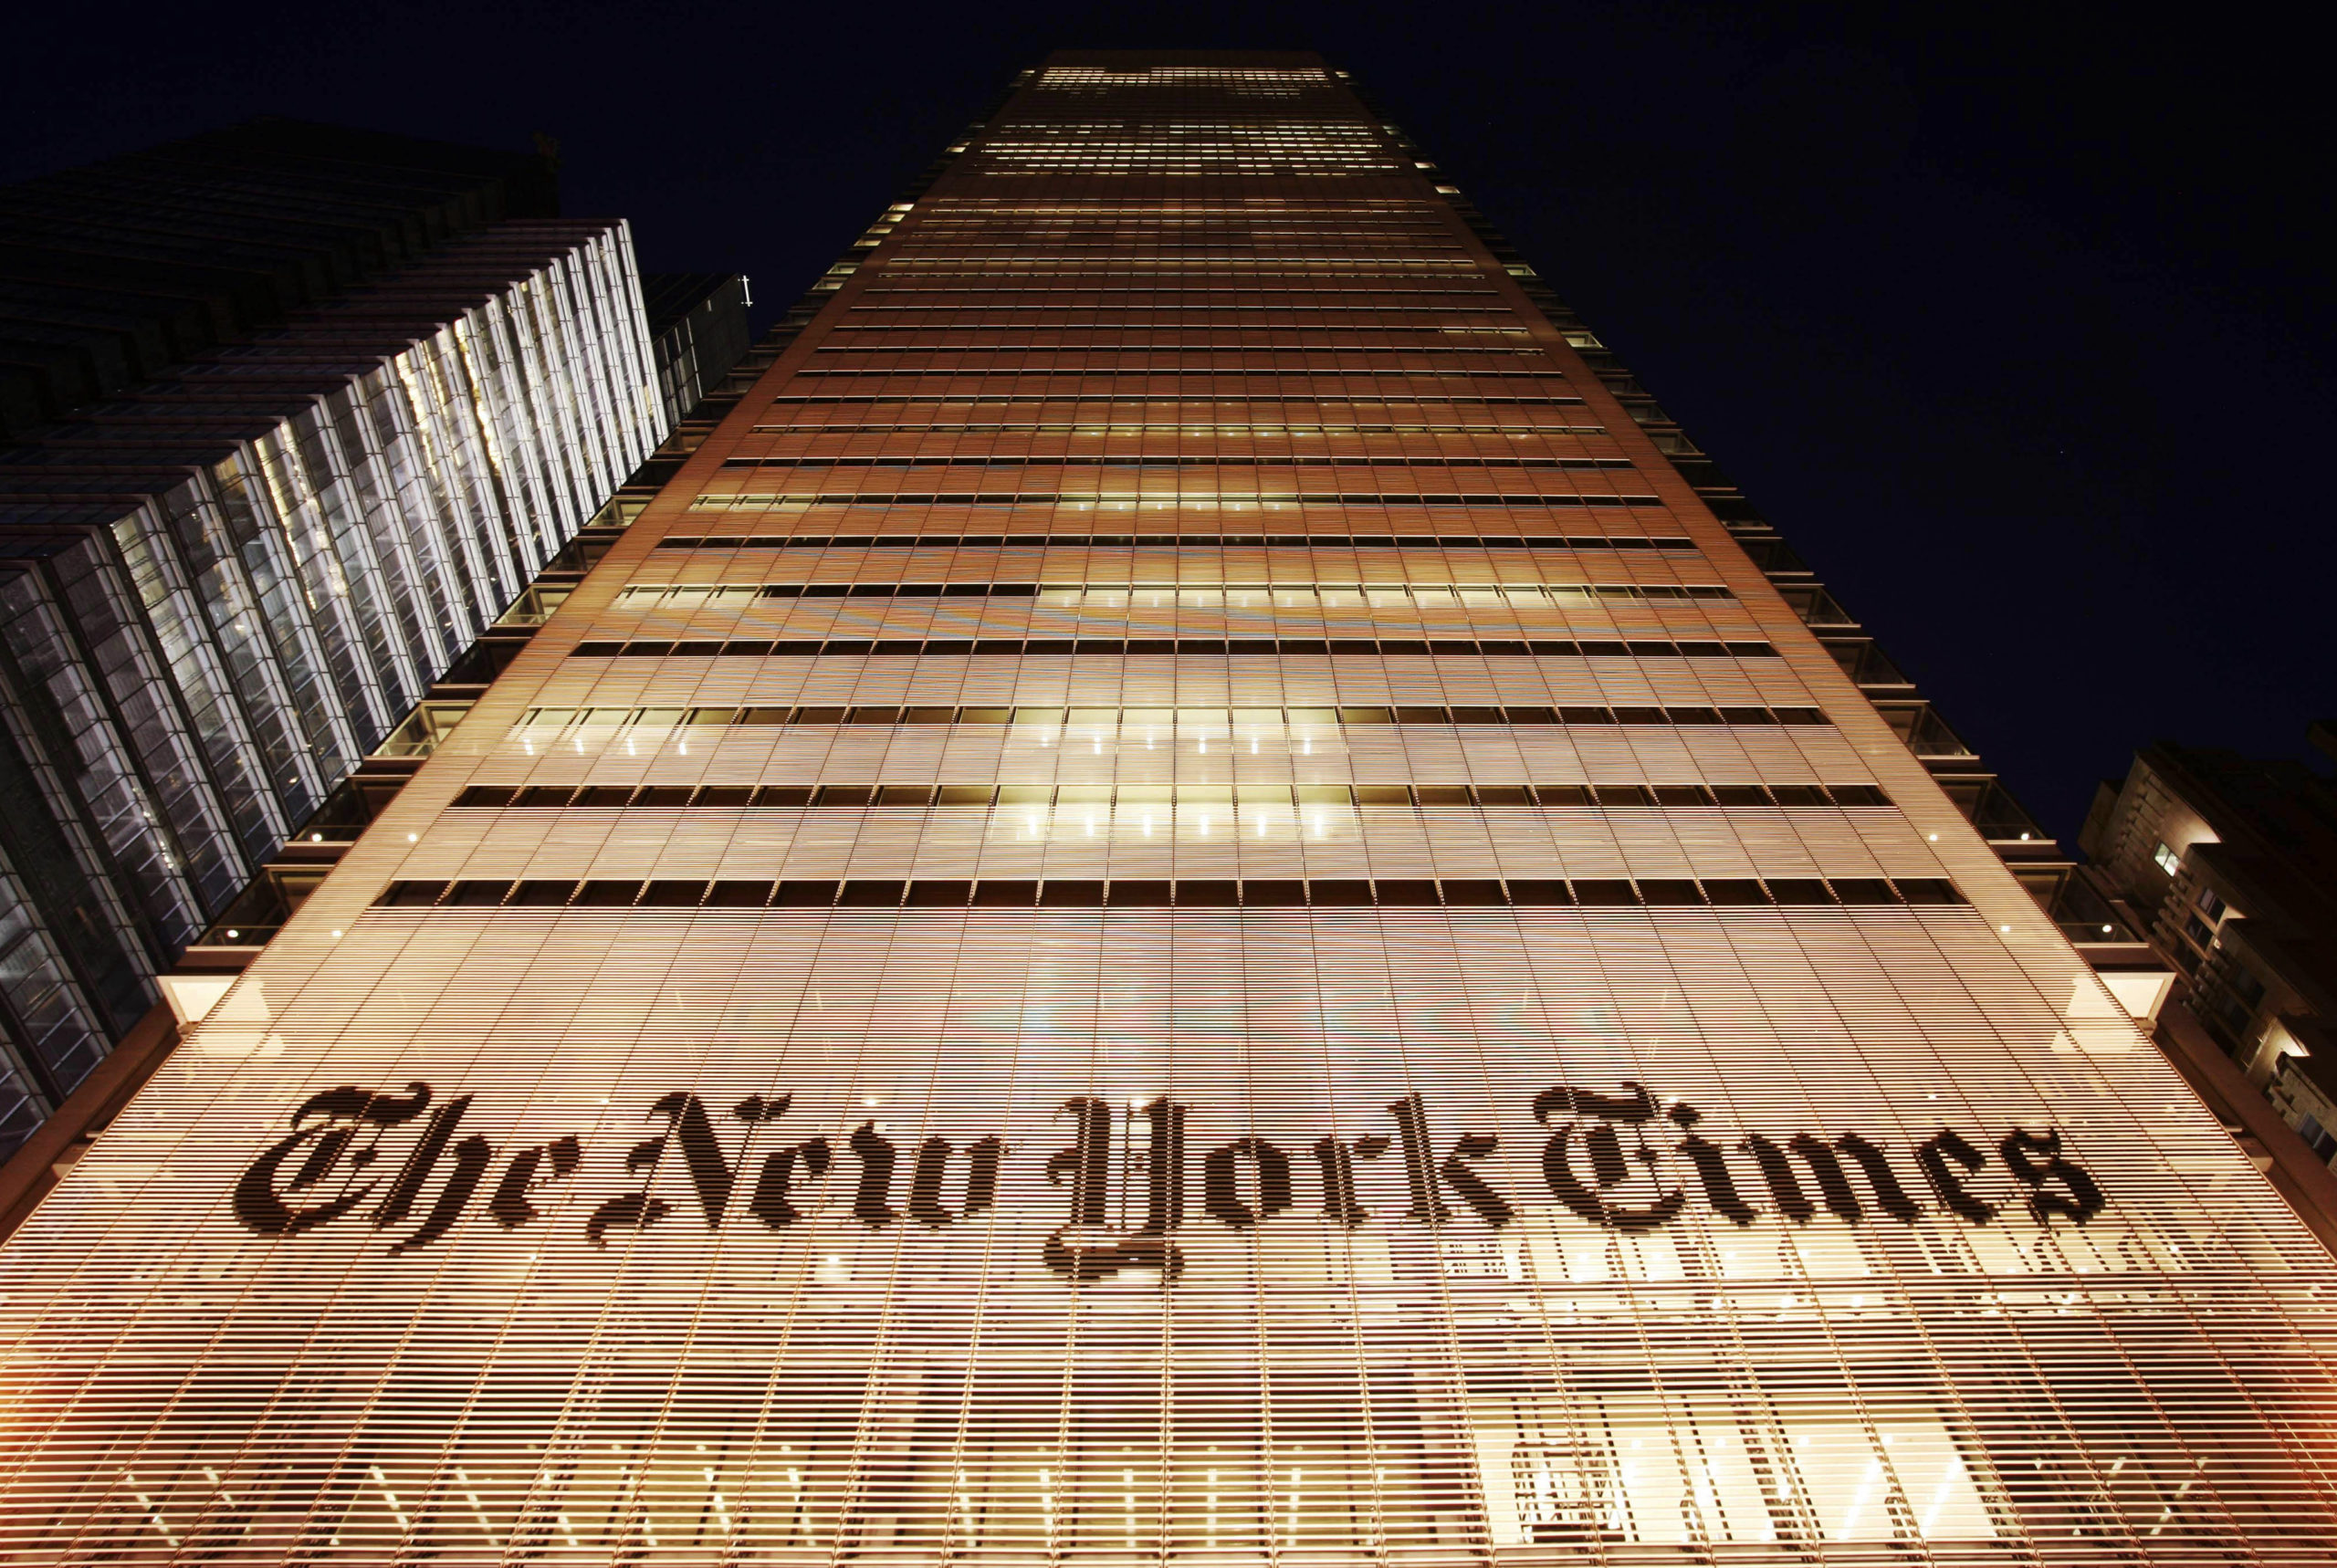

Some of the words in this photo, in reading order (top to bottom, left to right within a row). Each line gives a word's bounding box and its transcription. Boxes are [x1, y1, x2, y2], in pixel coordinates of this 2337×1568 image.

[233, 1082, 581, 1256] The
[585, 1090, 1010, 1250] New
[1043, 1092, 1515, 1288] York
[1533, 1081, 2105, 1236] Times
